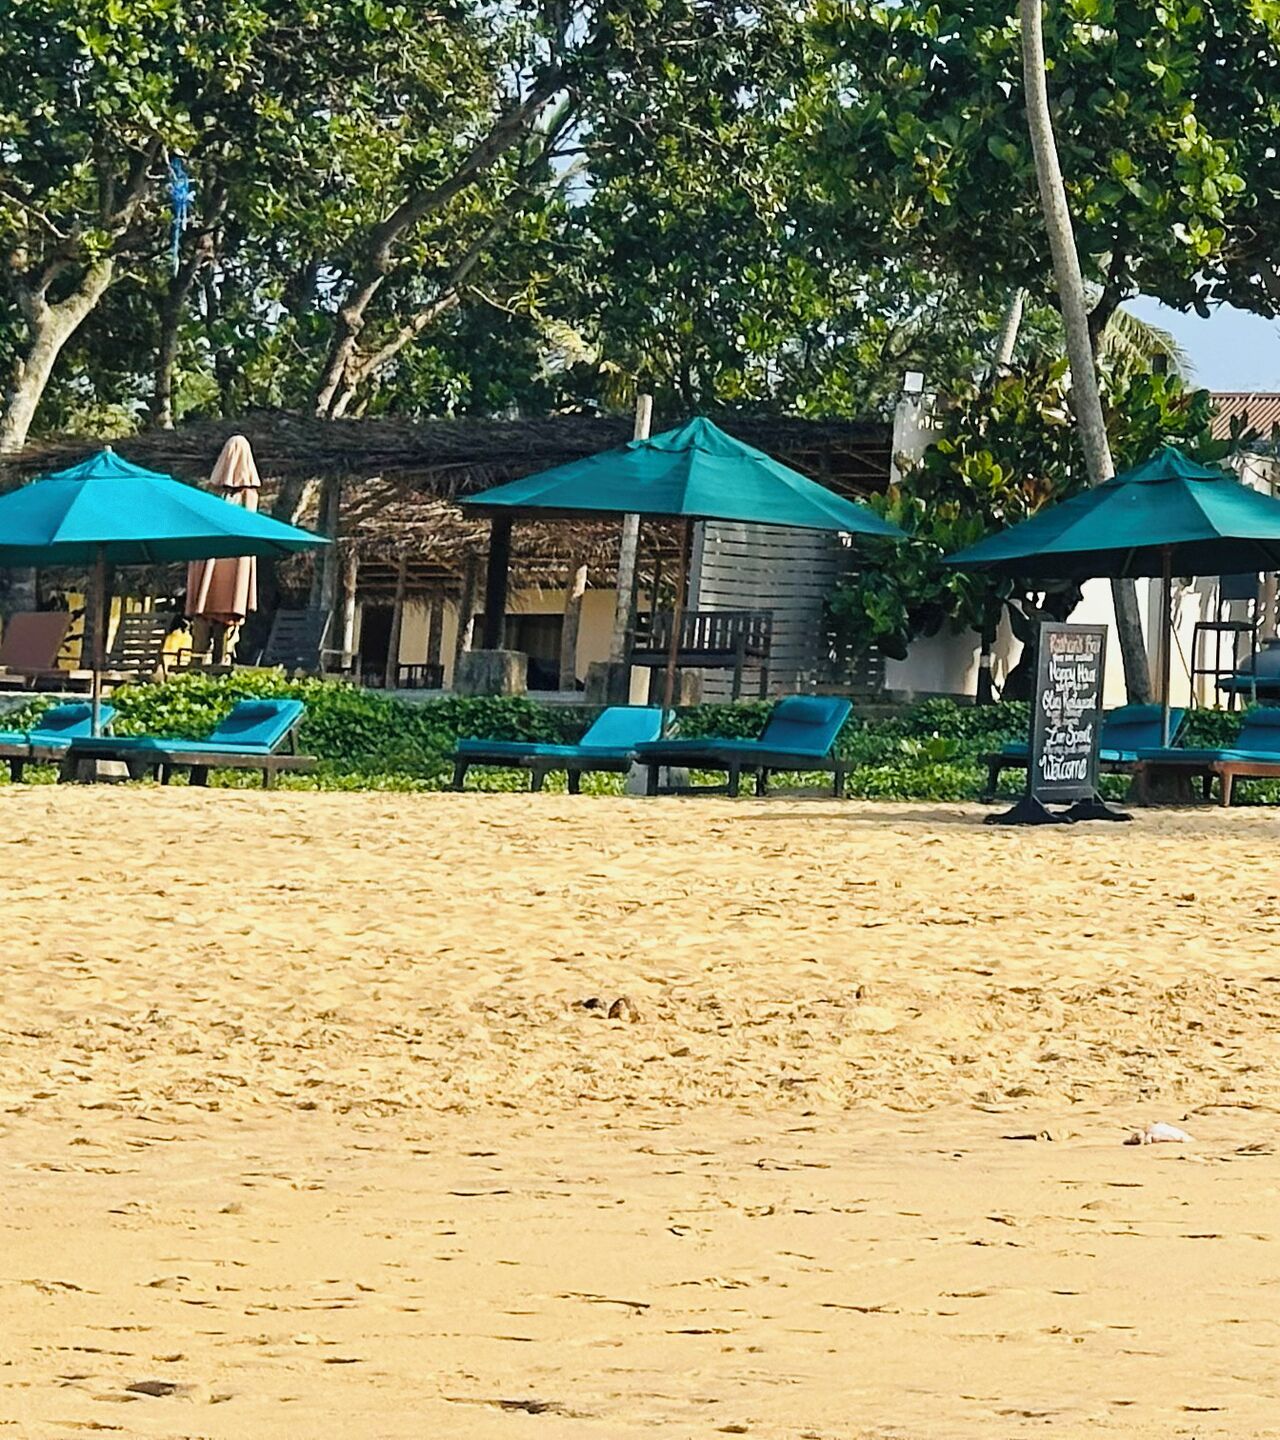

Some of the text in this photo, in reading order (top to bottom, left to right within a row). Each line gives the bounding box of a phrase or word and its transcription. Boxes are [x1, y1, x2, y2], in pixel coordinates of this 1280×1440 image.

[1049, 660, 1097, 685] Happy Hour
[1038, 754, 1087, 781] Welcome
